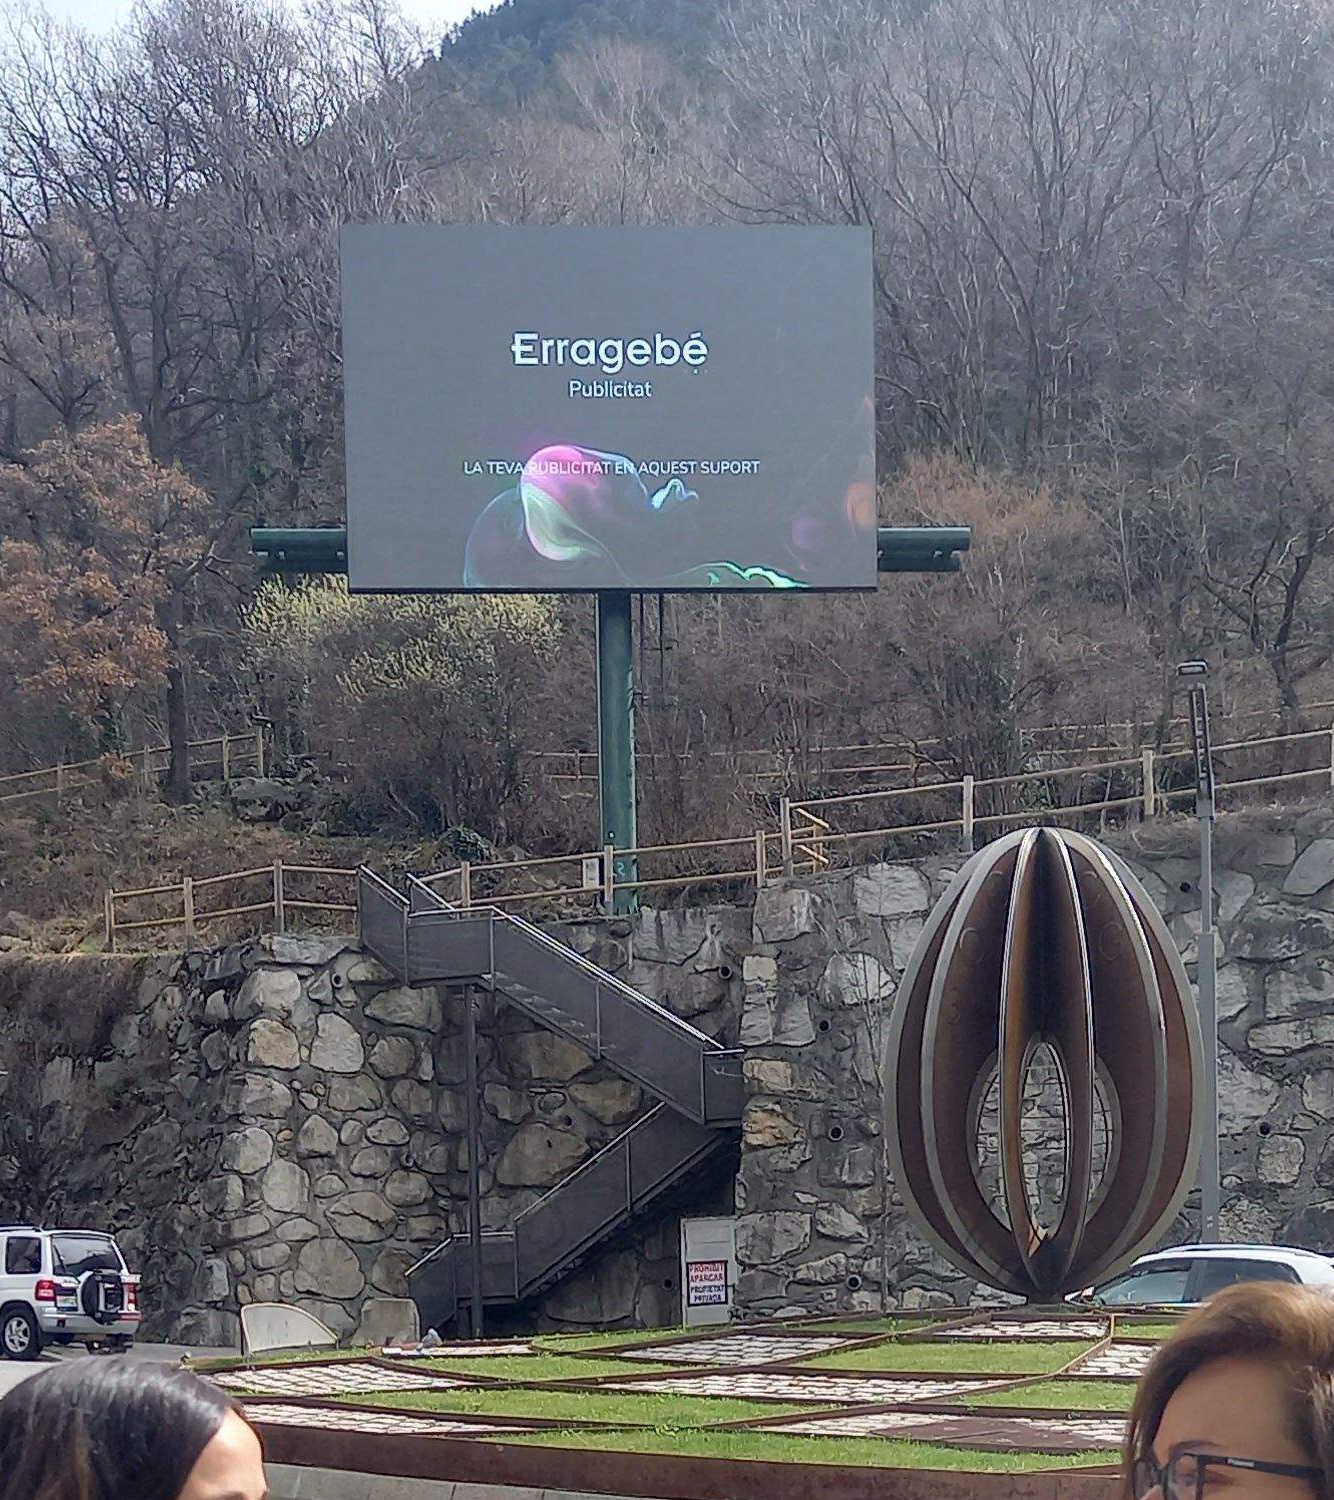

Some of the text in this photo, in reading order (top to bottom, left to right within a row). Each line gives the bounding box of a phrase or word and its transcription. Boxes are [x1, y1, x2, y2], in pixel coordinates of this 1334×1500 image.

[511, 331, 709, 374] Erragebé
[569, 379, 652, 398] Publicitat
[464, 460, 761, 477] LA TEVA PUBLICITAT EN AQUEST SUPORT
